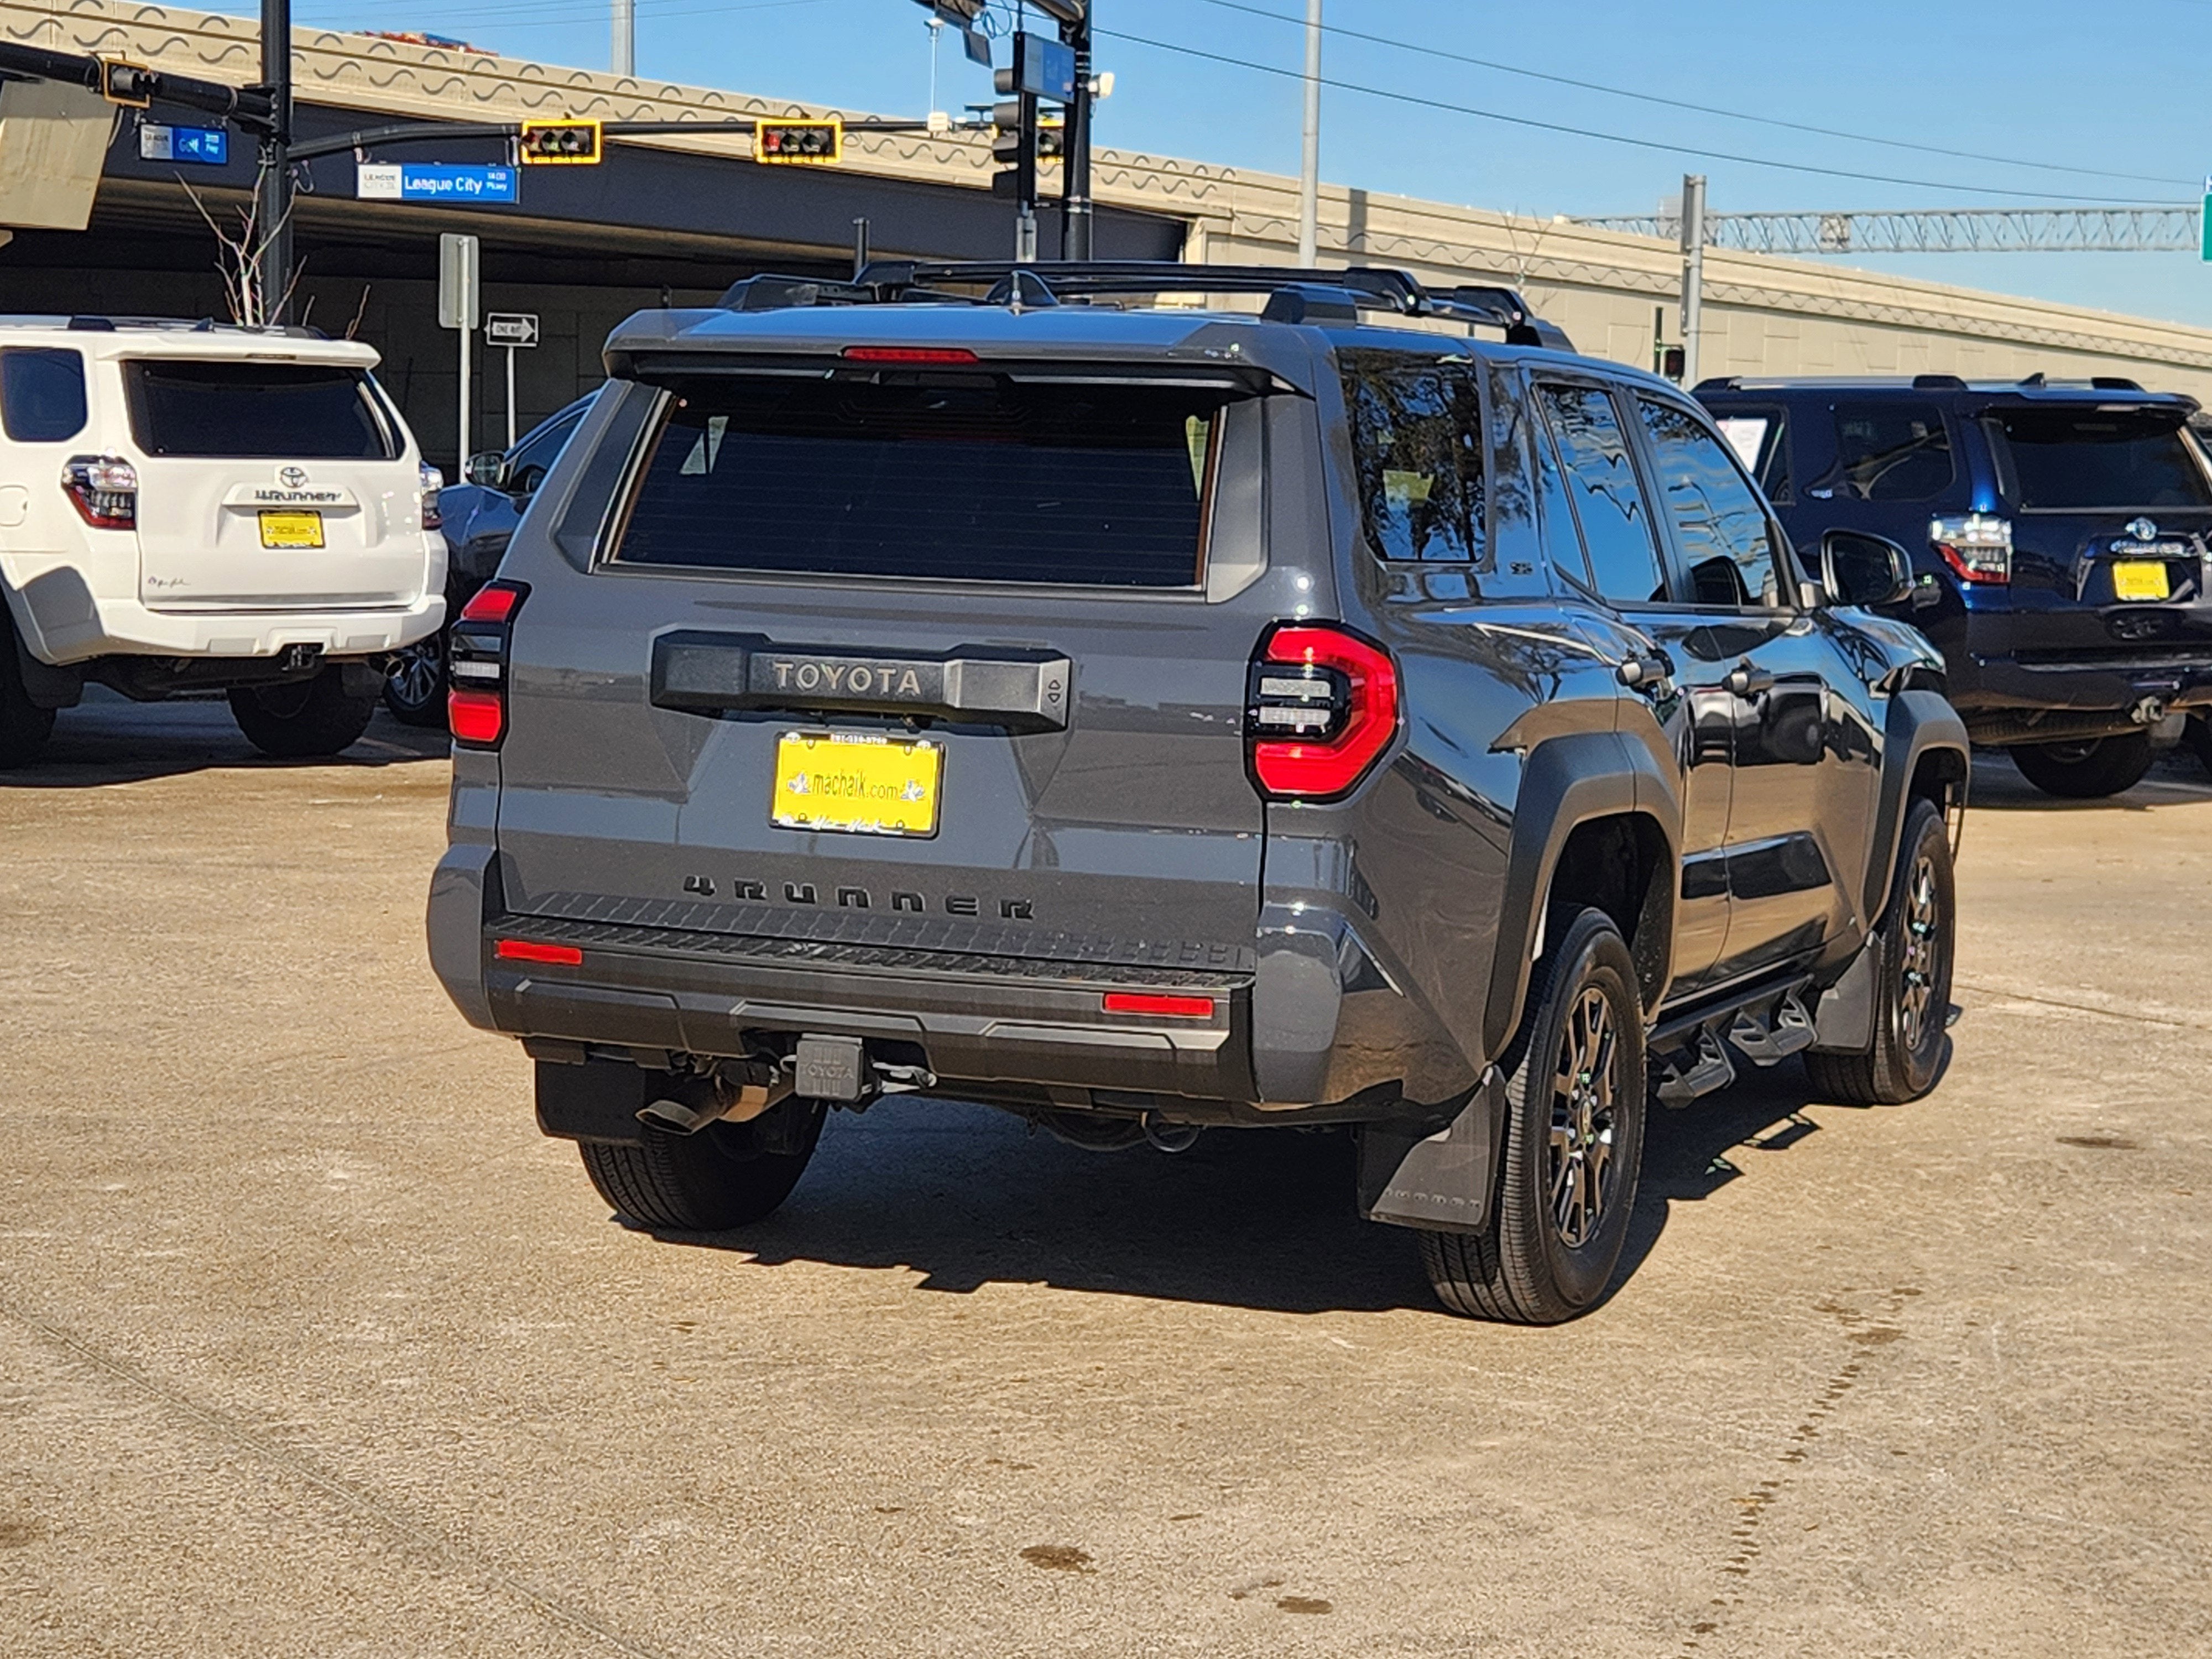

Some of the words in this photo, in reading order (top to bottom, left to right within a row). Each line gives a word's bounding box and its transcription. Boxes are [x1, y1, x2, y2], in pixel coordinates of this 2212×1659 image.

[405, 175, 453, 195] League
[456, 177, 482, 195] City
[774, 662, 921, 695] TOYOTA
[812, 768, 899, 799] machaik.com
[683, 875, 1034, 921] 4RUNNER
[800, 1062, 855, 1081] TOYOTA
